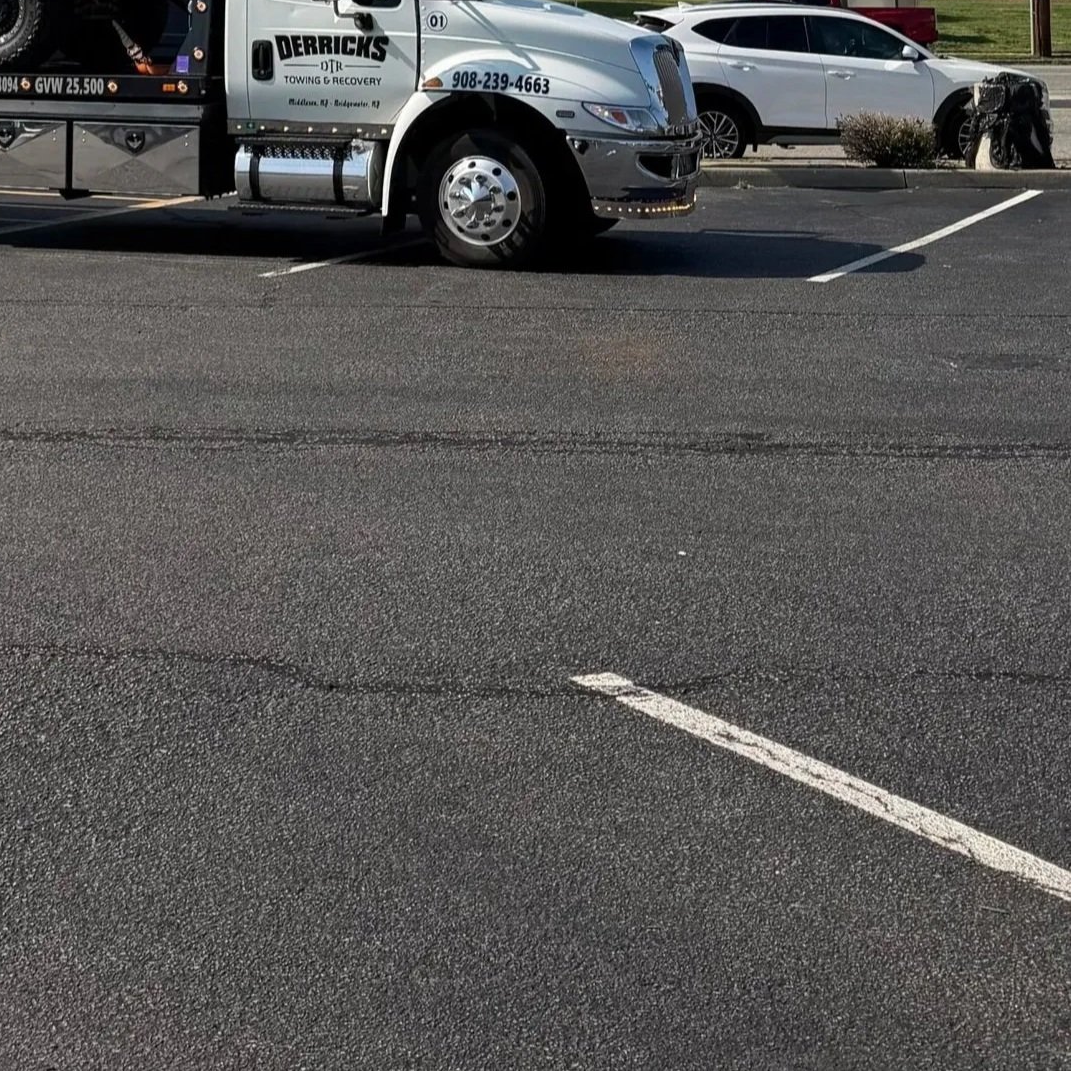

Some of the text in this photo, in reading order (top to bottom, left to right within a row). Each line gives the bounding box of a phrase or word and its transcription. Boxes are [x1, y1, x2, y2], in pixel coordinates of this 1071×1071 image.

[430, 15, 444, 28] 01
[274, 35, 389, 62] DERRICKS
[320, 59, 343, 74] DTR
[34, 77, 63, 94] GVW
[284, 75, 382, 86] TOWING & RECOVERY
[452, 71, 550, 94] 908-239-4663
